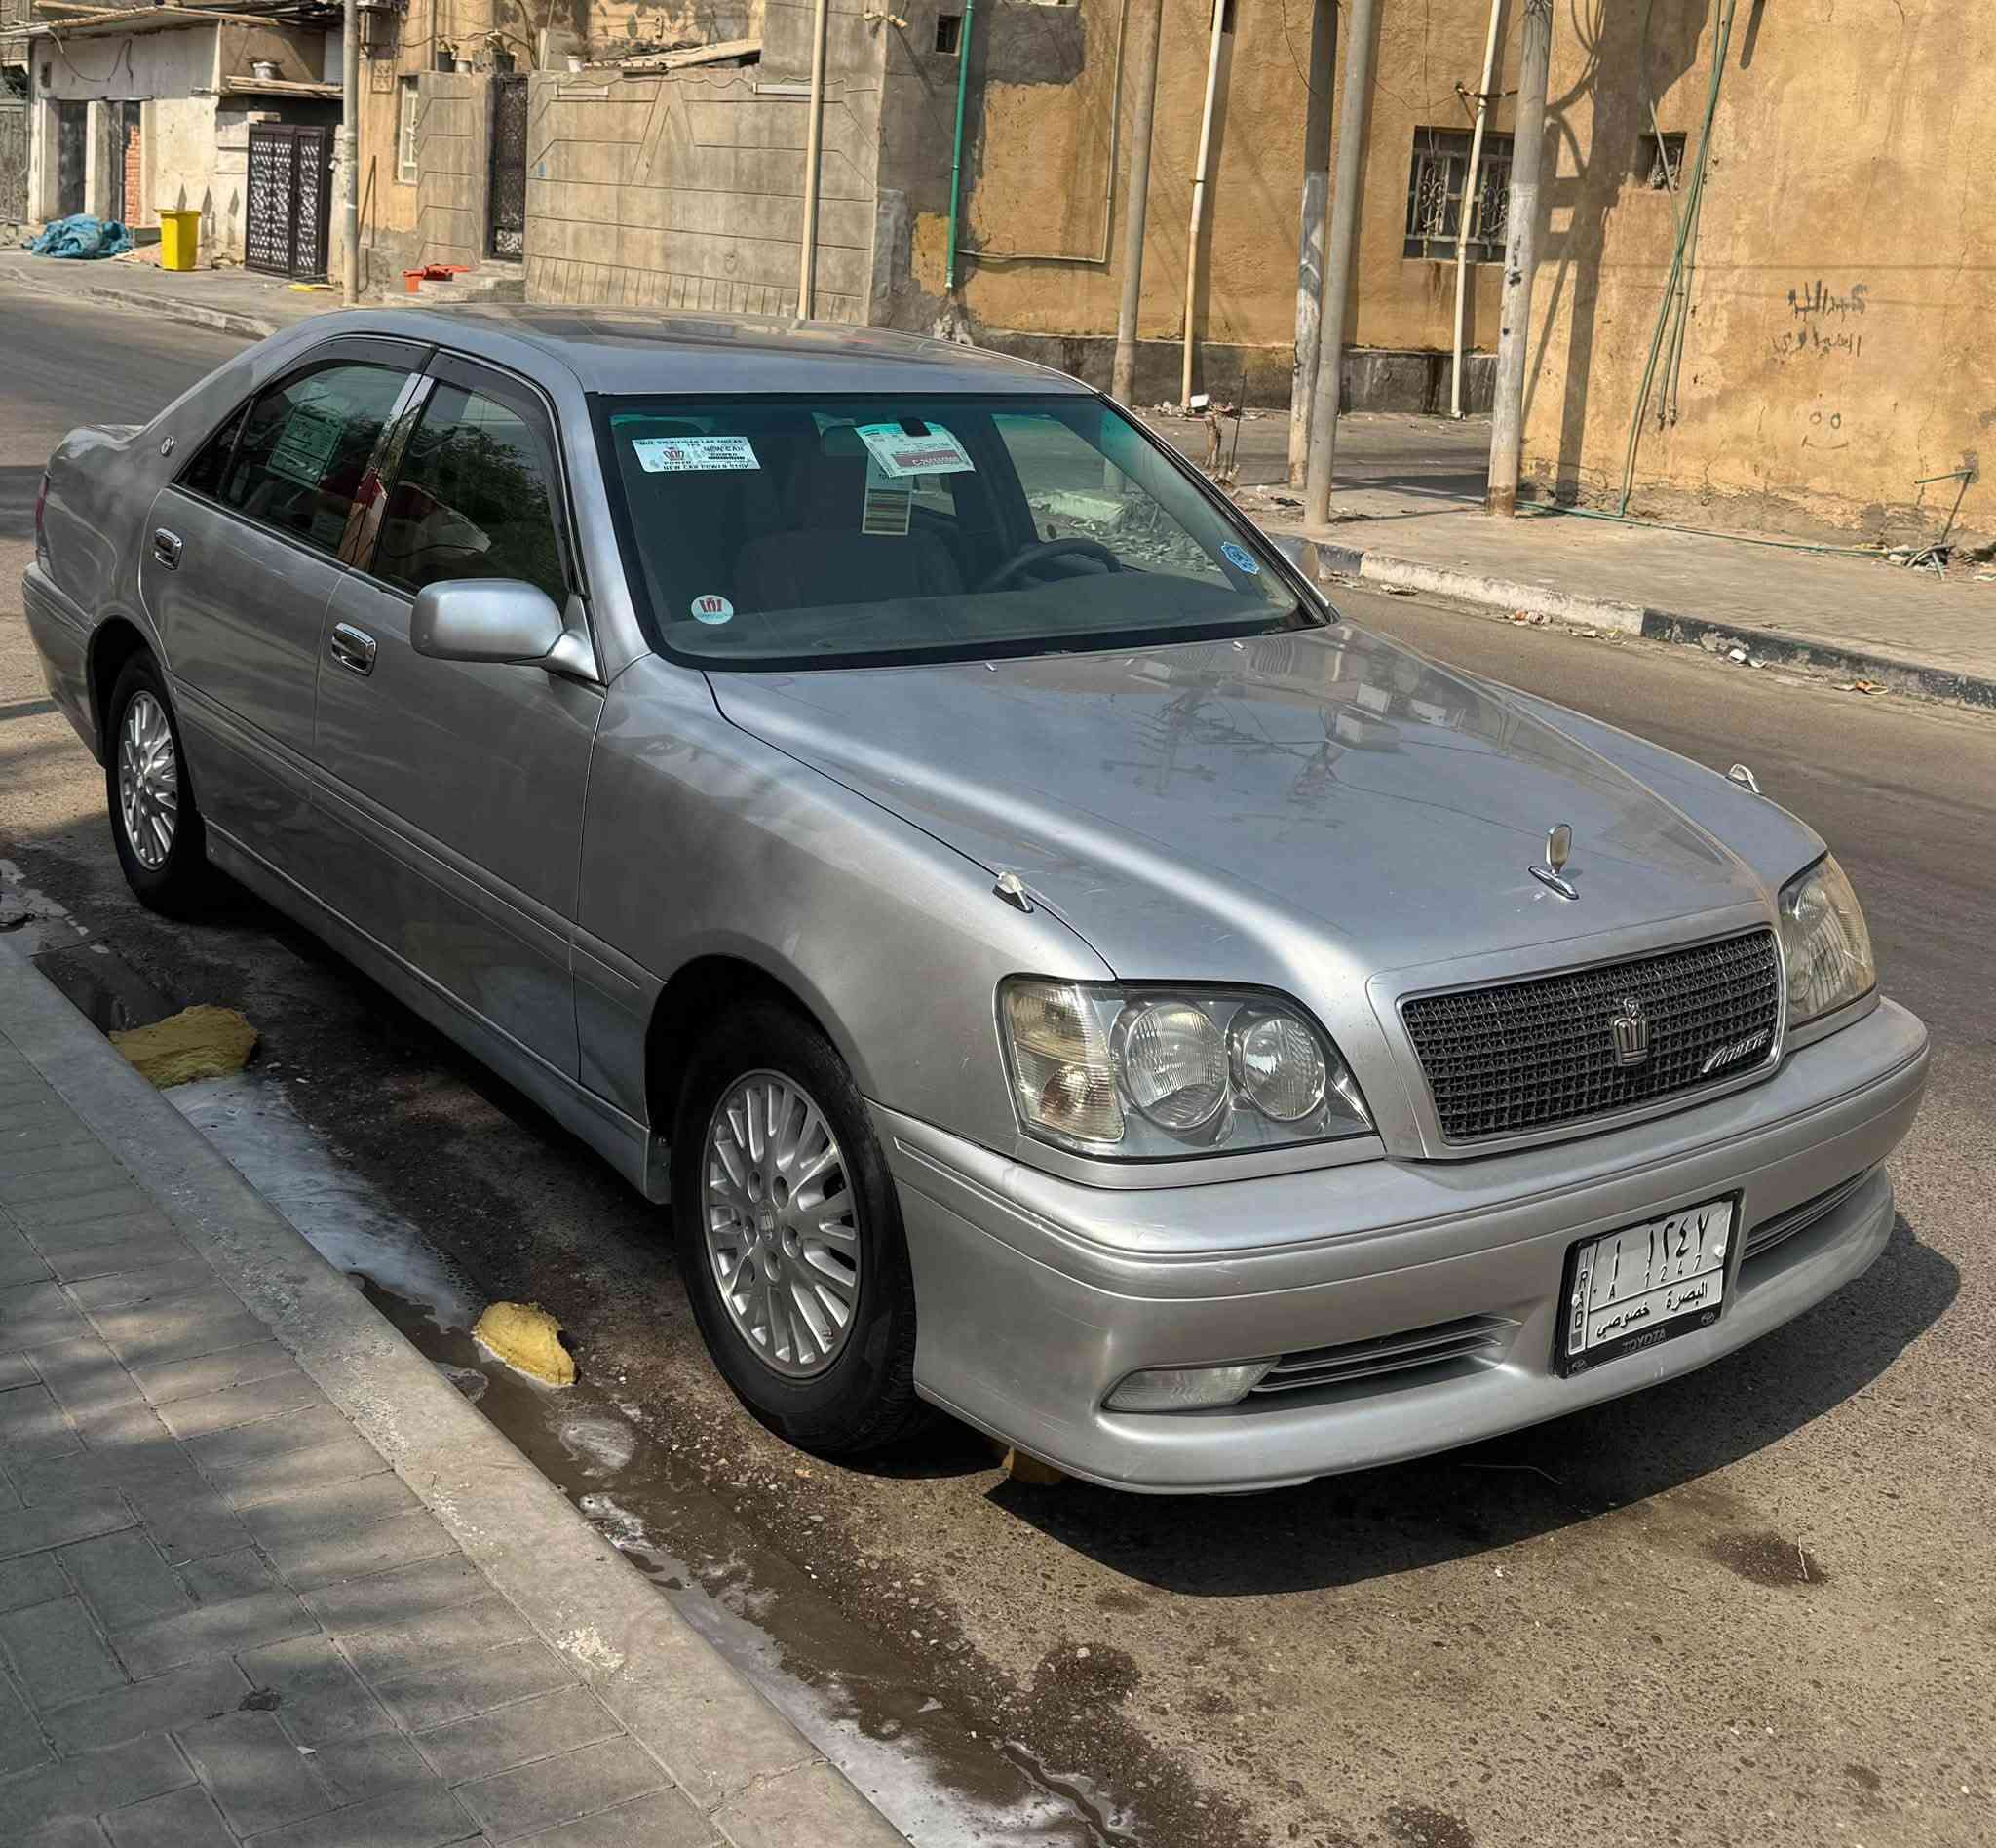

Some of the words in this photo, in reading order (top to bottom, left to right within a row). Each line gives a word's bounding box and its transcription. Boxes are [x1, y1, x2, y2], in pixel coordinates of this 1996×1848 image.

[1647, 1212, 1709, 1267] ١٢٤٧
[1607, 1283, 1617, 1300] A
[1665, 1280, 1708, 1311] البصرة
[1595, 1301, 1651, 1340] خصوصي
[1621, 1328, 1668, 1352] TOYOTA
